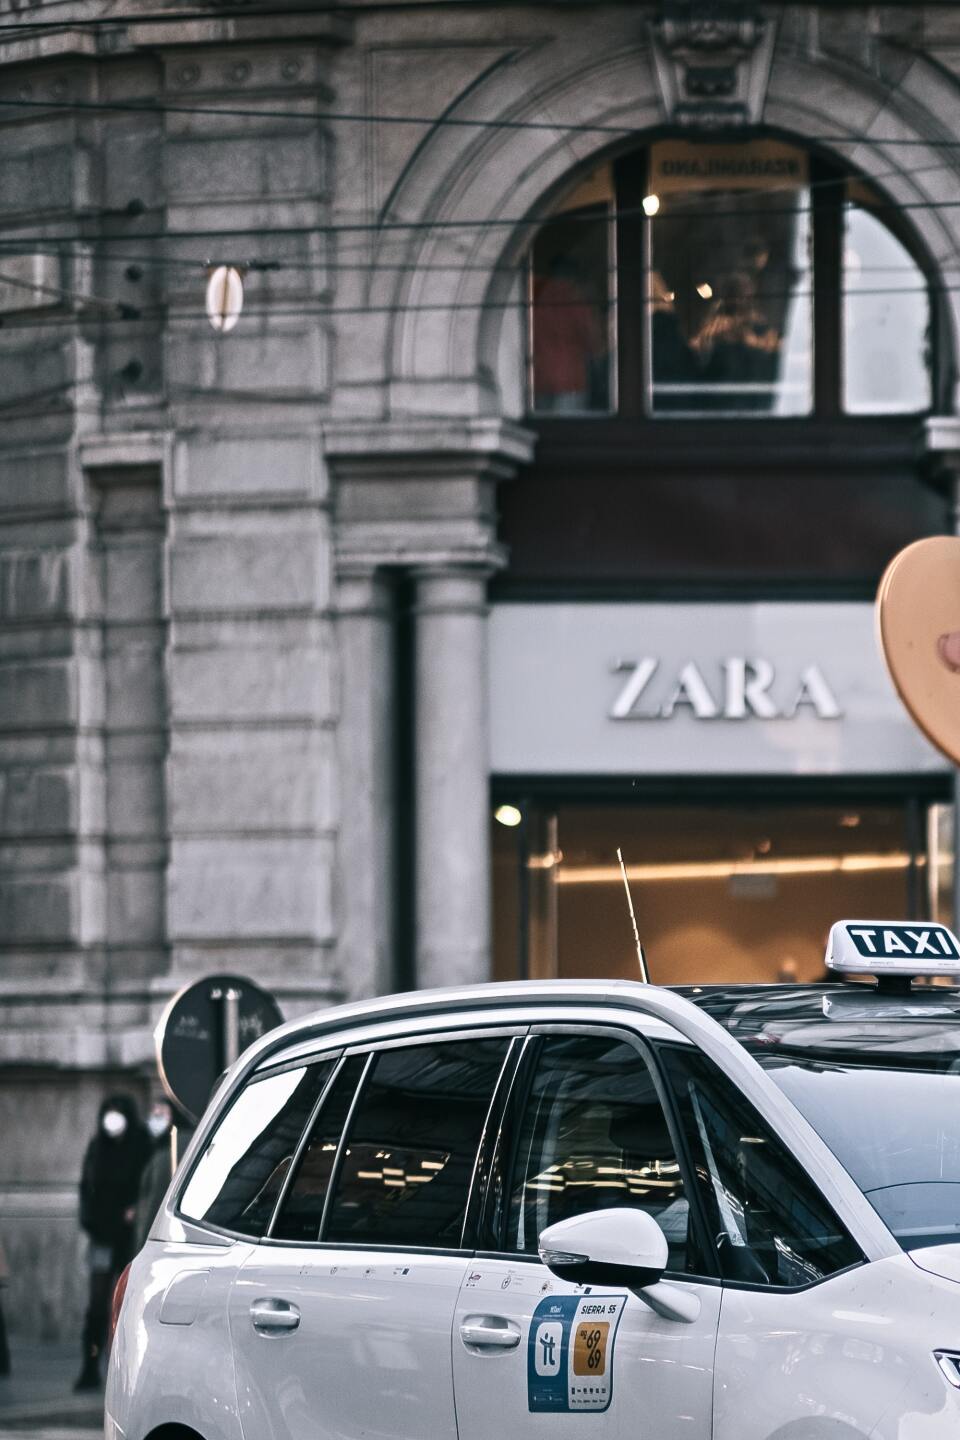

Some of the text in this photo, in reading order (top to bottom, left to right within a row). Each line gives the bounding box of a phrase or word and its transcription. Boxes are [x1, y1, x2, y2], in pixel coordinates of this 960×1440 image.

[607, 656, 845, 721] ZARA
[850, 929, 953, 955] TAXI
[581, 1305, 606, 1315] SIERRA
